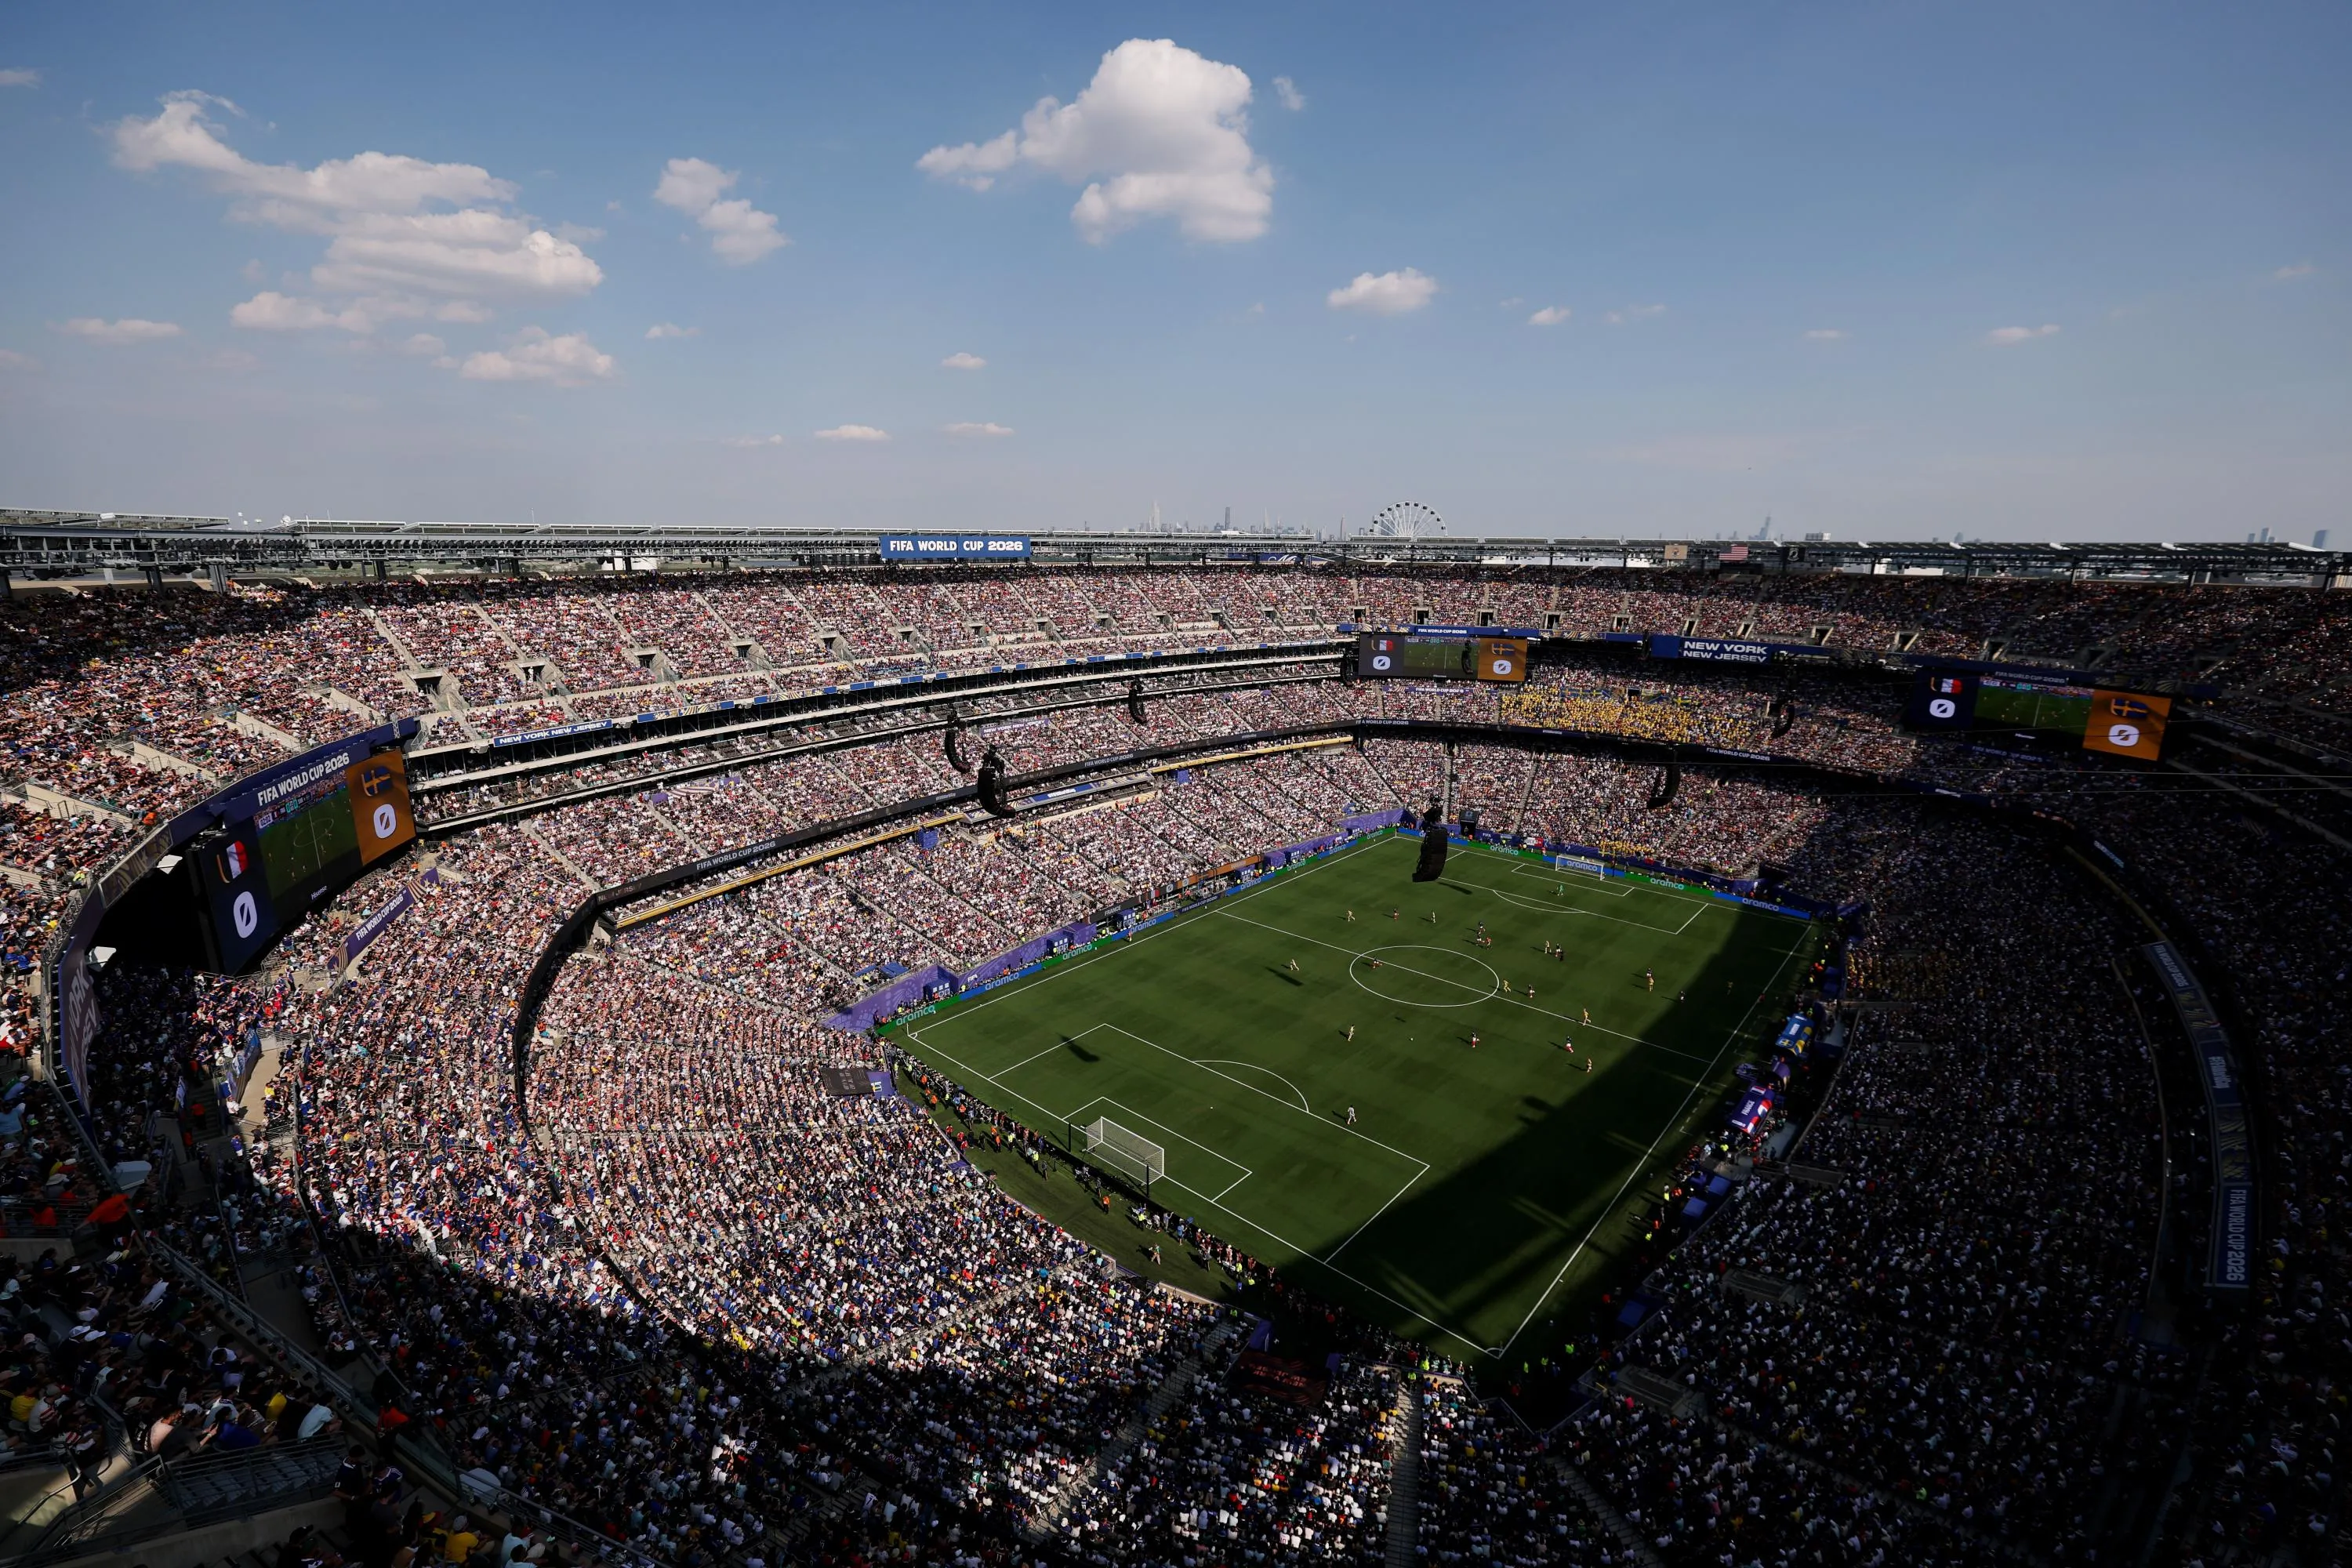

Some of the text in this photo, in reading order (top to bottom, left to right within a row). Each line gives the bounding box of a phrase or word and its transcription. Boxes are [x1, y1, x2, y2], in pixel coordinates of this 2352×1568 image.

[890, 540, 1023, 551] FIFA WORLD CUP 2026
[1684, 641, 1768, 655] NEW YORK
[1682, 650, 1767, 662] NEW JERSEY
[1929, 699, 1955, 718] 0
[499, 721, 608, 745] NEW YORK NEW JERSEY
[257, 752, 350, 807] FIFA WORLD CUP 2026
[372, 804, 397, 840] 0
[696, 841, 775, 870] FIFA WORLD CUP 2026
[1490, 844, 1519, 855] aramco
[1287, 859, 1306, 871] aramco
[1566, 860, 1598, 871] aramco
[1240, 877, 1261, 890] aramco
[1650, 877, 1685, 890] aramco
[1105, 905, 1121, 916] FRANCE
[1742, 898, 1780, 912] aramco
[233, 891, 257, 938] 0
[355, 894, 404, 941] FIFA WORLD CUP 2026
[1130, 918, 1156, 934] aramco
[1062, 943, 1093, 960] aramco
[2153, 945, 2167, 953] FIFA
[2158, 952, 2176, 965] WORLD
[985, 972, 1019, 990] aramco
[2171, 972, 2190, 987] 2026
[69, 960, 89, 1042] YORK
[895, 1004, 935, 1026] aramco
[2226, 1189, 2246, 1281] FIFA WORLD CUP 2026
